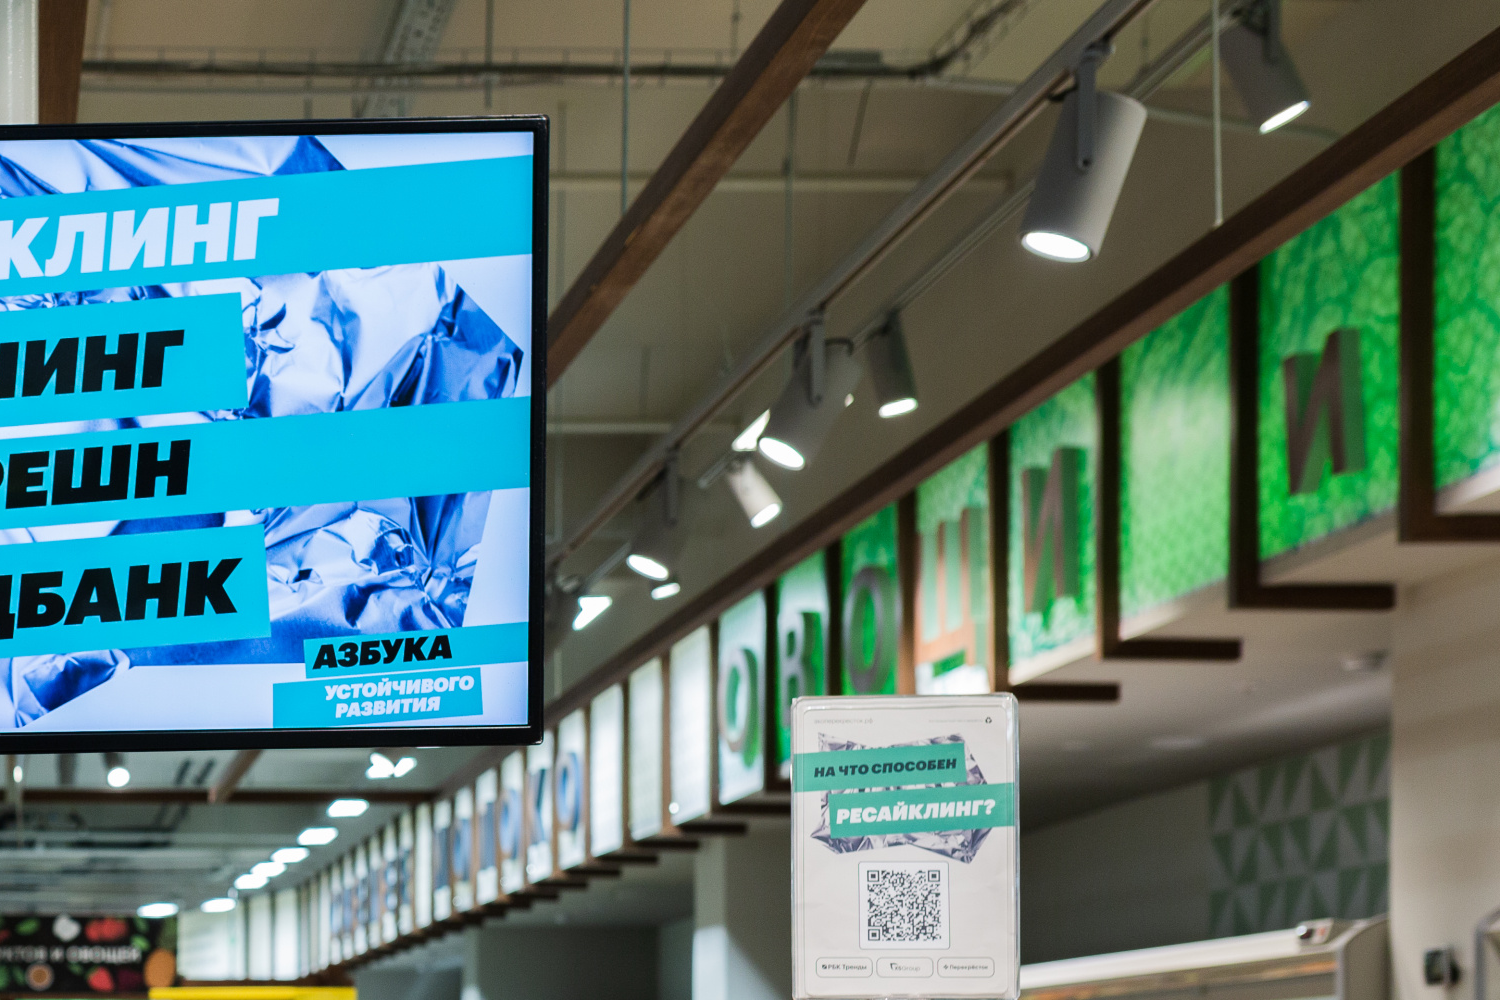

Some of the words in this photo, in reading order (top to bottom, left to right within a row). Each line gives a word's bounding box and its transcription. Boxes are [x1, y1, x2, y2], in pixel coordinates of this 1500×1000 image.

[312, 635, 453, 670] АЗБУКА
[324, 674, 476, 702] УСТОЙЧИВОГО
[334, 696, 442, 719] РАЗВИТИЯ
[814, 766, 836, 778] НА
[838, 763, 869, 776] ЧТО
[871, 758, 958, 775] СПОСОБЕН
[836, 798, 996, 825] РЕСАЙКЛИНГ?
